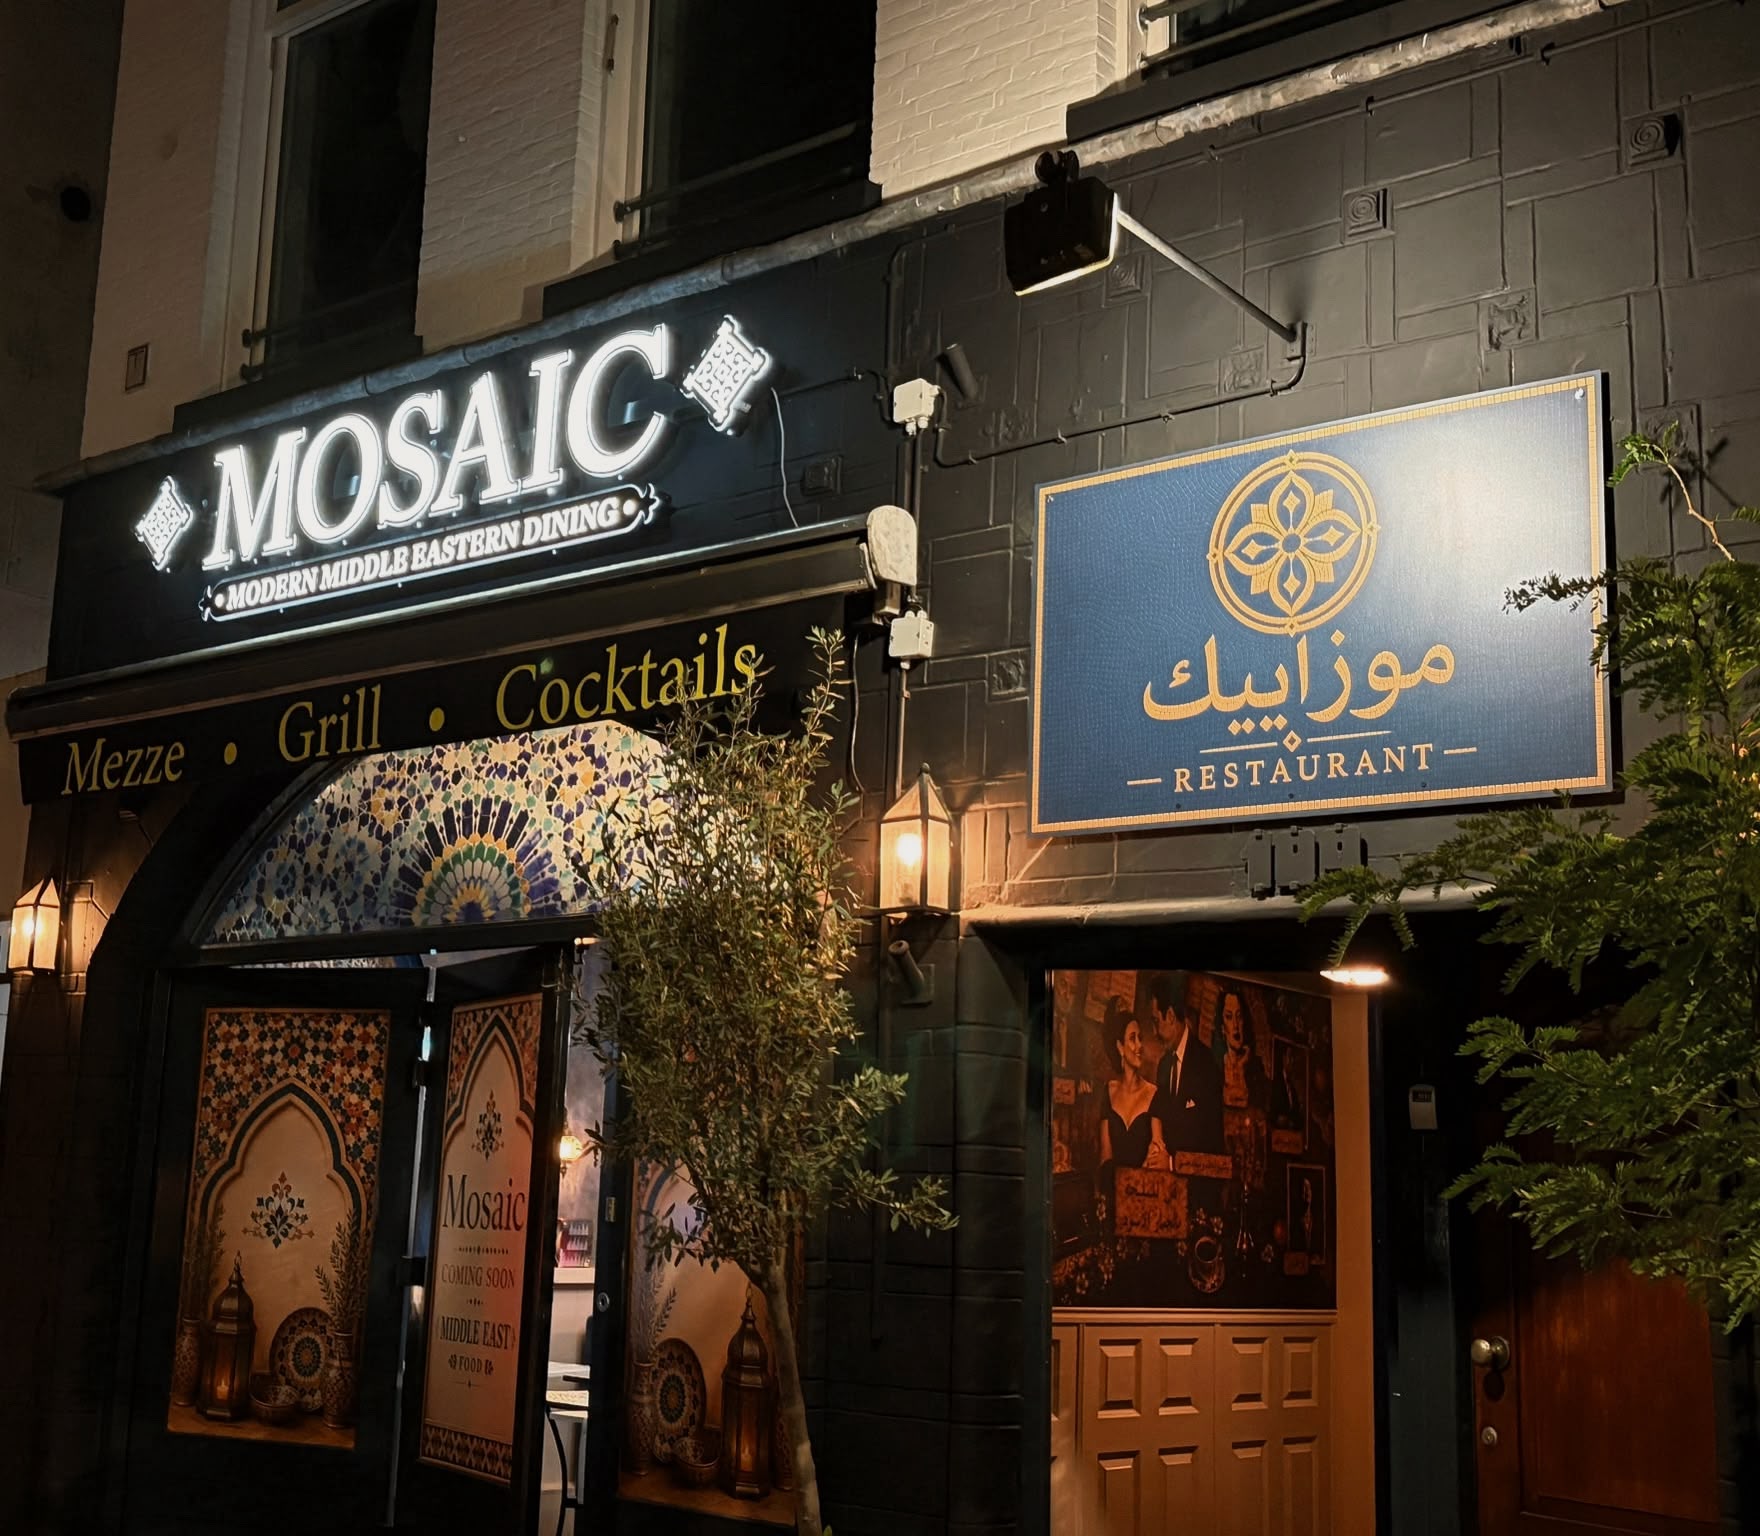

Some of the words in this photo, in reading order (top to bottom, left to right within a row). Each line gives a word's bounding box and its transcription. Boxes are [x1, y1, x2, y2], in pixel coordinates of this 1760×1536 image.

[202, 322, 667, 571] MOSAIC
[225, 566, 319, 611] MODERN
[318, 546, 409, 592] MIDDLE
[410, 521, 522, 571] EASTERN
[521, 498, 620, 545] DINING
[61, 737, 185, 797] Mezze
[278, 684, 383, 763] Grill
[495, 622, 757, 732] Cocktails
[1143, 629, 1456, 736] موزاييك
[1173, 743, 1434, 794] RESTAURANT
[441, 1174, 526, 1232] Mosaic
[441, 1263, 483, 1287] COMING
[485, 1269, 515, 1289] SOON
[440, 1316, 480, 1345] MIDDLE
[457, 1354, 483, 1373] FOOD
